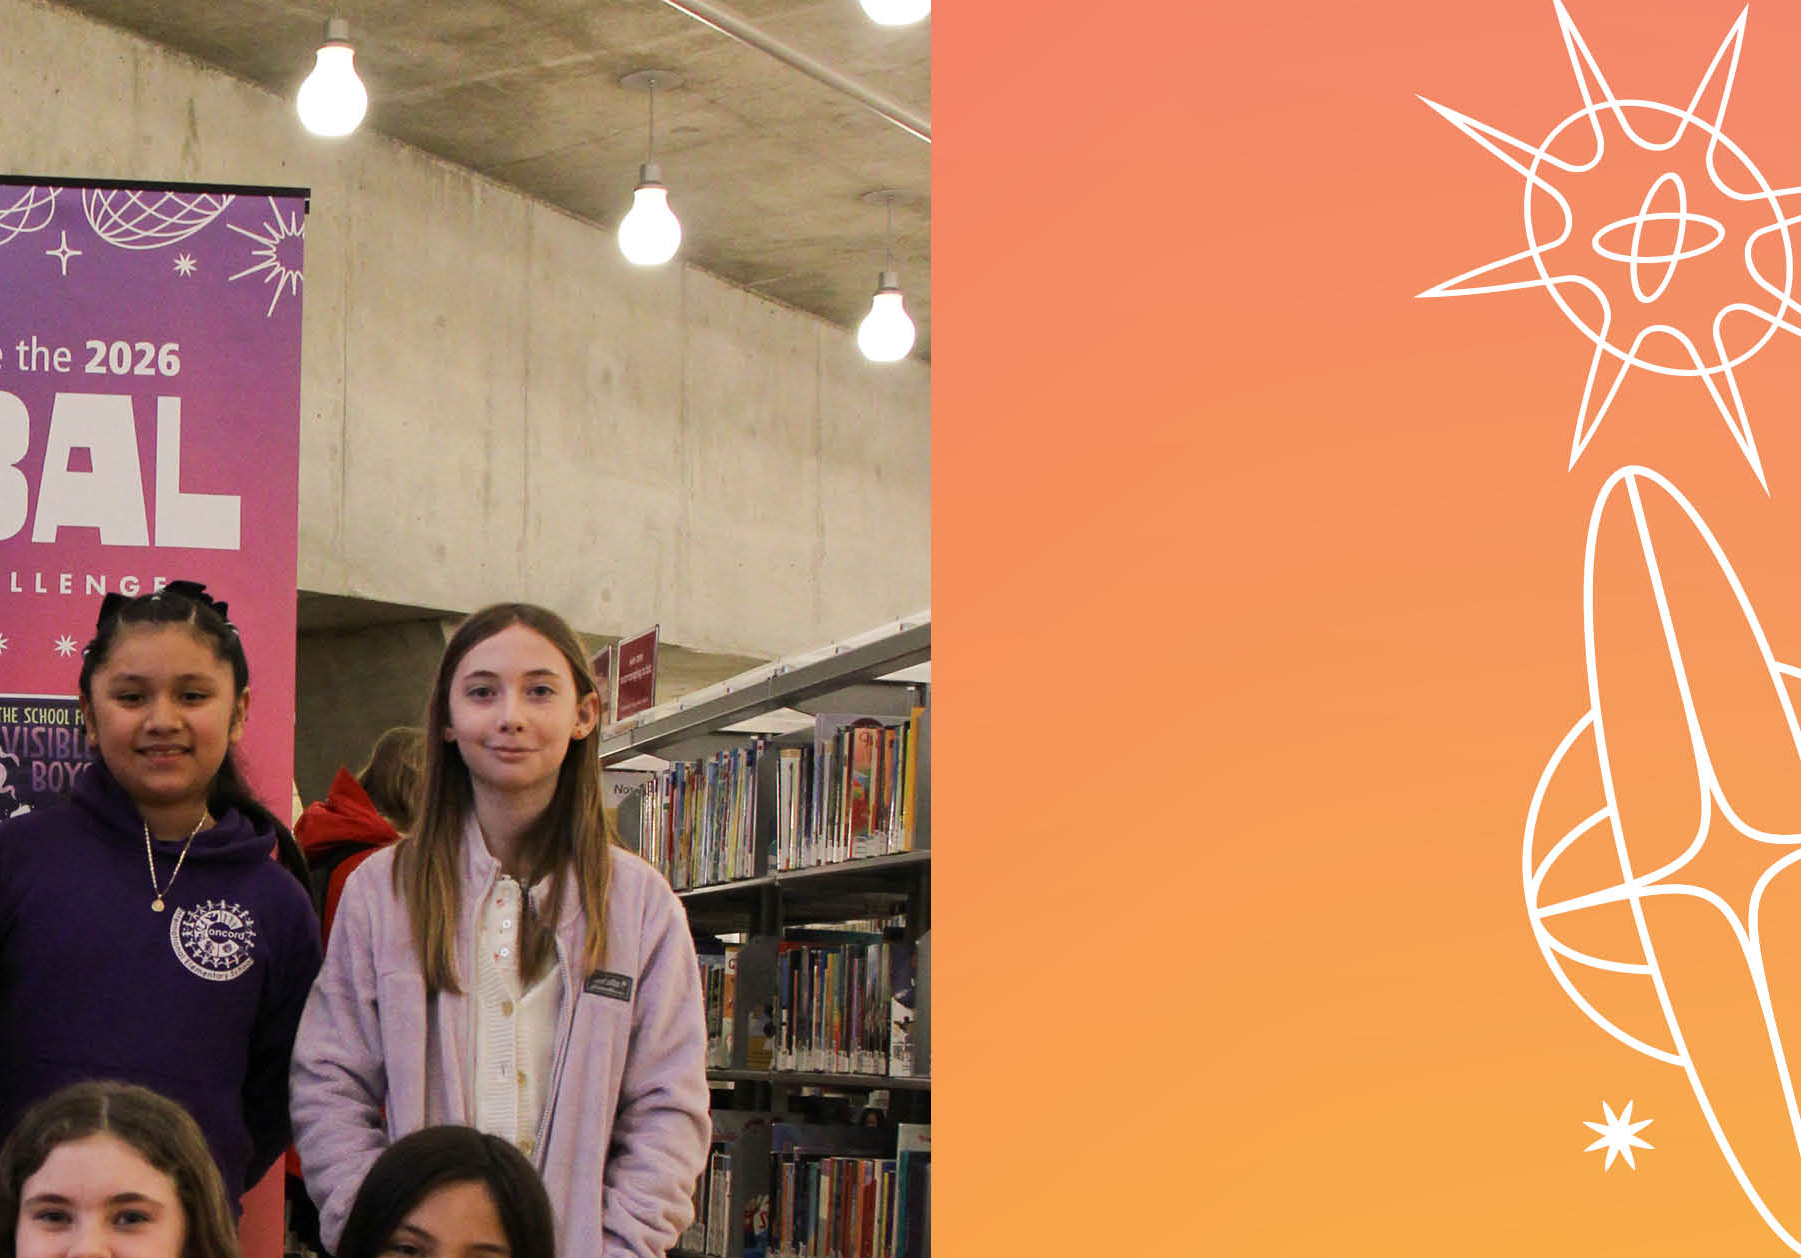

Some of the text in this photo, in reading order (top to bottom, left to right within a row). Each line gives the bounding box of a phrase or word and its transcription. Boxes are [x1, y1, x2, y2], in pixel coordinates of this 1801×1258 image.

[16, 336, 72, 372] the
[84, 340, 181, 376] 2026
[24, 707, 69, 725] SCHOOL
[32, 761, 93, 793] BOY
